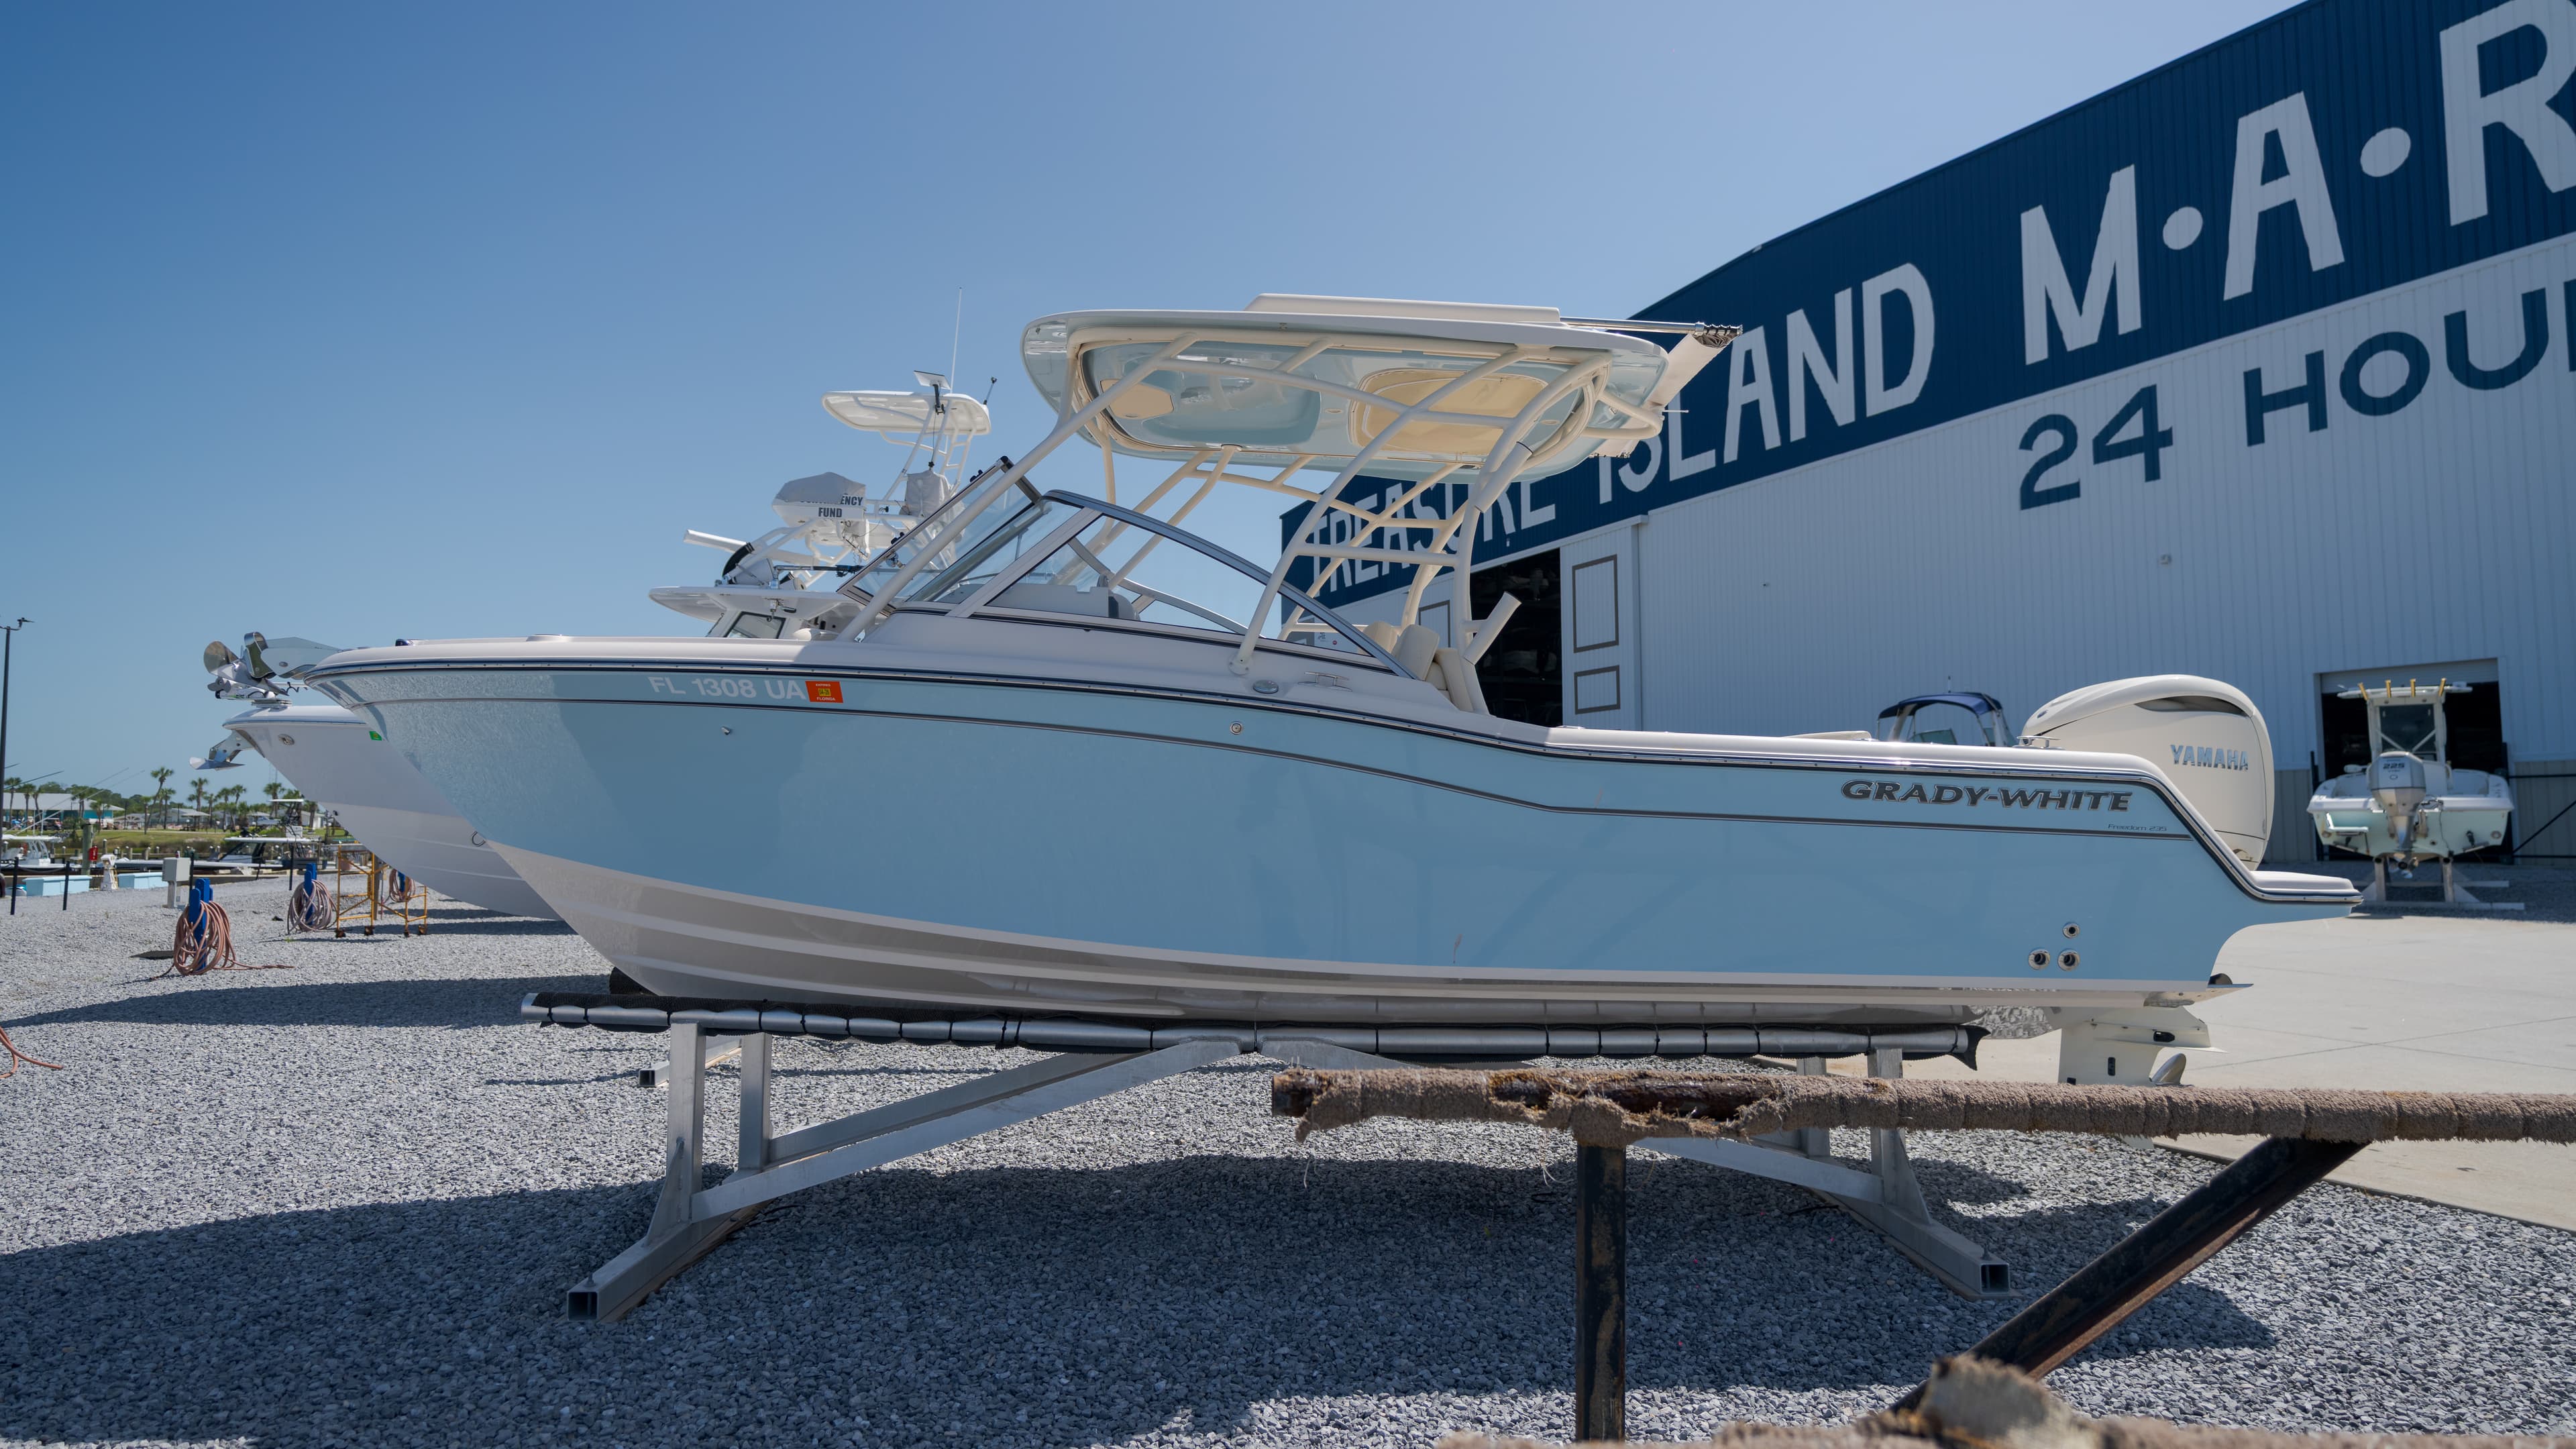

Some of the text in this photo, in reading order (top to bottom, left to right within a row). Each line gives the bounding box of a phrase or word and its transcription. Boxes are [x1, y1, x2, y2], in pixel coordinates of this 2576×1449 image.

[2019, 278, 2576, 511] 24 HOU
[818, 507, 843, 518] FUND
[647, 676, 806, 700] FL 1308 UA
[2170, 744, 2249, 771] YAMAHA
[1841, 779, 2133, 812] GRADY-WHITE
